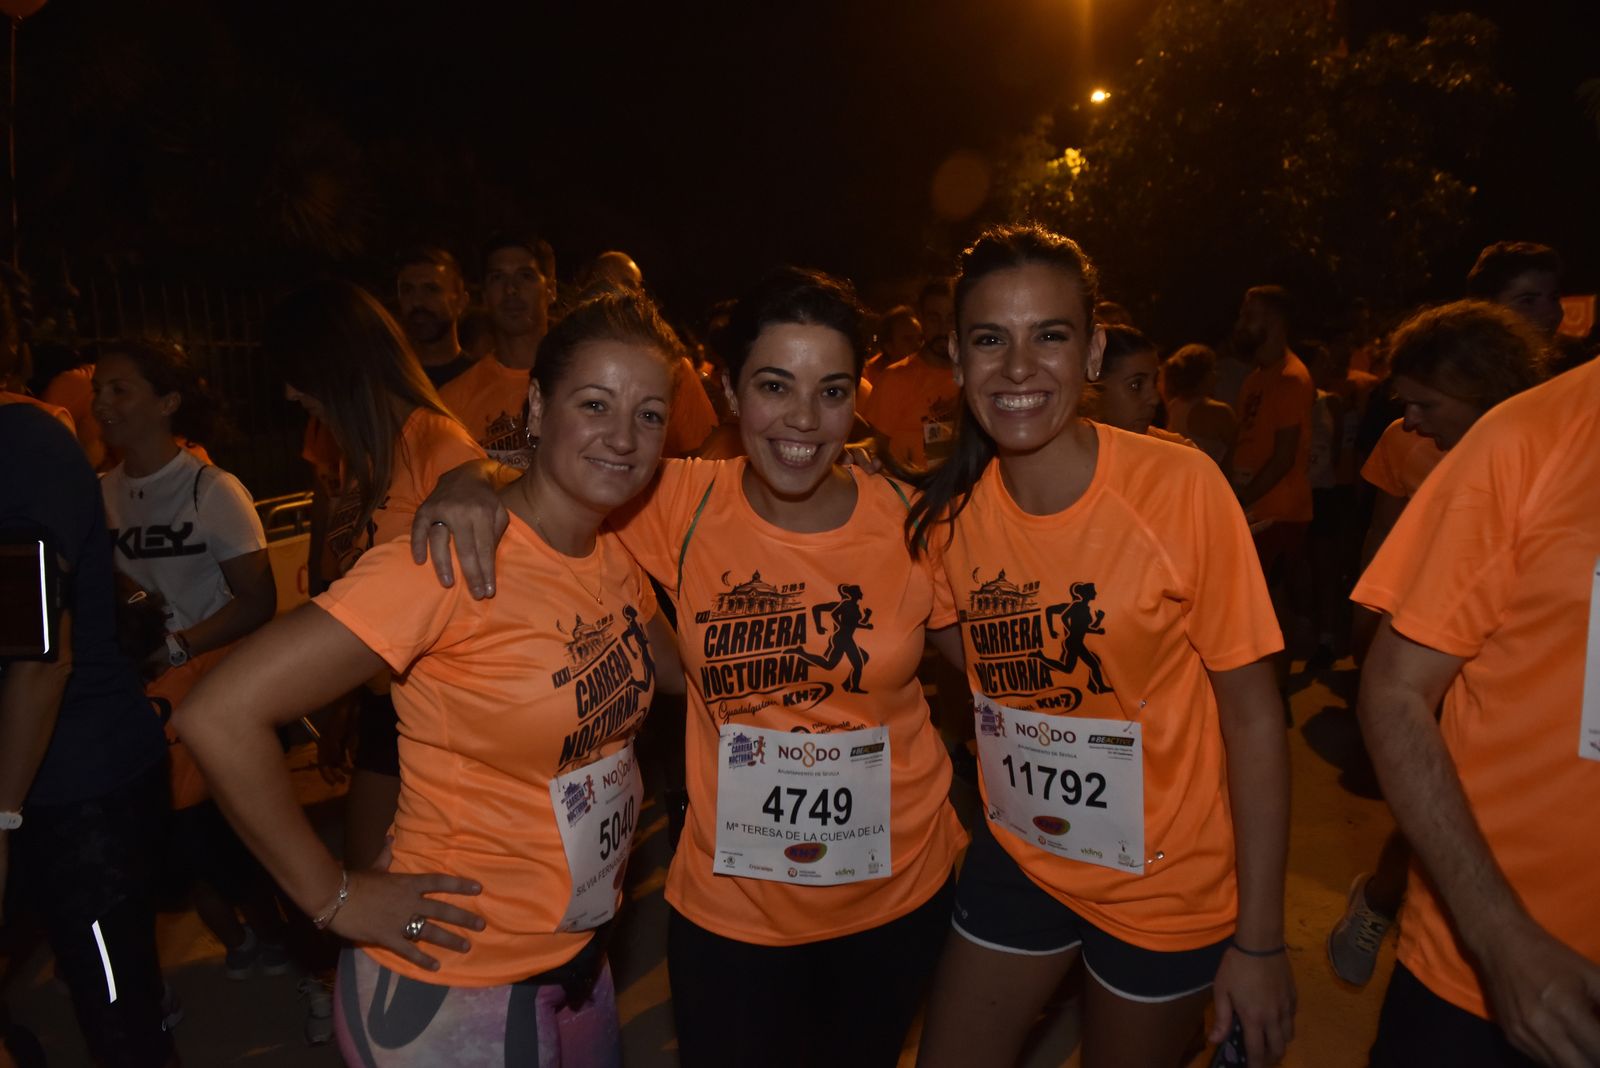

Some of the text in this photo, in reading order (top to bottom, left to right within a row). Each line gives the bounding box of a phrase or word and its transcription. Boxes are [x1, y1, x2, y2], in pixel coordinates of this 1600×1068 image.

[111, 522, 207, 560] KLEY
[703, 612, 807, 658] CARRERA
[970, 614, 1044, 655] CARRERA
[551, 666, 572, 689] XXXI
[575, 643, 633, 719] CARRERA
[700, 655, 809, 699] NOCTURNA
[782, 687, 823, 707] KH7
[1036, 693, 1072, 709] KH7
[558, 687, 641, 768] NOCTURNA
[1002, 754, 1108, 809] 11792
[762, 785, 853, 826] 4749
[599, 795, 634, 861] 5040
[726, 821, 885, 842] Mª TERESA DE LA CUEVA DE LA
[575, 874, 598, 897] SILVIA
